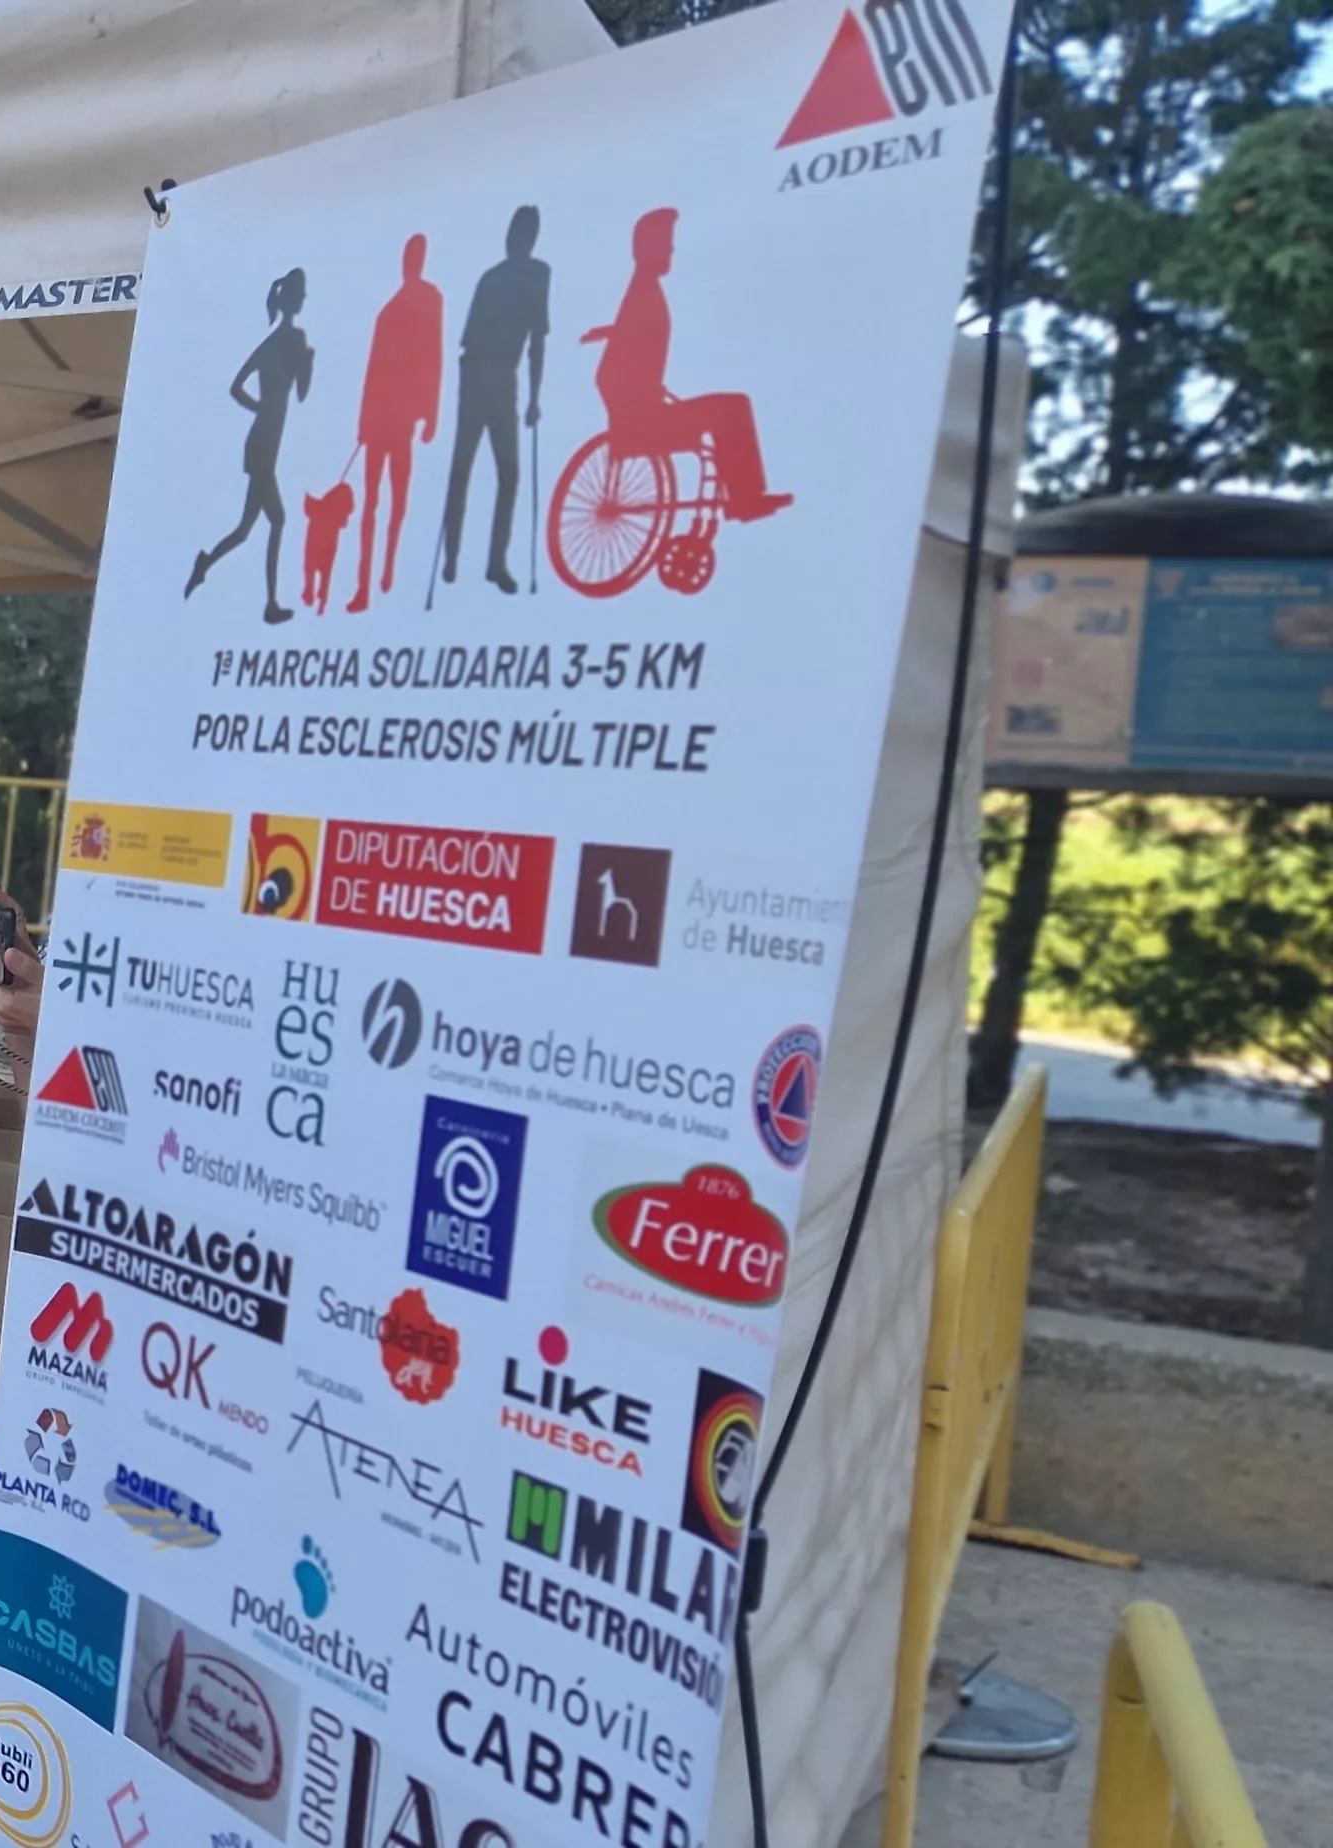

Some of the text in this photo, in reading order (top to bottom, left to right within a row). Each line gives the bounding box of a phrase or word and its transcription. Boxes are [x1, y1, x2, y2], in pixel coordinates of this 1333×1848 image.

[778, 127, 945, 192] AODEM
[237, 648, 360, 688] MARCHA
[368, 645, 551, 688] SOLIDARIA
[562, 644, 629, 689] 3-5
[637, 642, 706, 690] KM
[193, 710, 716, 772] POR LA ESCLEROSIS MÚLTIPLE
[335, 829, 522, 880] DIPUTACIÓN
[330, 877, 513, 933] DE HUESCA
[683, 919, 825, 966] de Huesca
[127, 956, 255, 1012] TUHUESCA
[215, 1012, 253, 1029] HUESCA
[431, 1012, 735, 1108] hoya de huesca
[153, 1069, 242, 1117] sanofi
[428, 1064, 731, 1141] Comarca Hoya de Huesca Plana de Uesca
[182, 1145, 382, 1233] Bristol Myers Squibb
[19, 1177, 293, 1298] ALTOARAGÓN
[422, 1245, 493, 1279] ESCUER
[424, 1210, 494, 1262] MIGUEL
[629, 1198, 783, 1288] Ferrer
[50, 1231, 260, 1328] SUPERMERCADOS
[27, 1346, 108, 1393] MAZANA
[141, 1321, 269, 1435] QK MENDO
[499, 1405, 642, 1477] HUESCA
[61, 1492, 91, 1523] RCD
[233, 1586, 390, 1696] podoactiva
[405, 1603, 694, 1789] Automóviles
[298, 1706, 344, 1847] GRUPO
